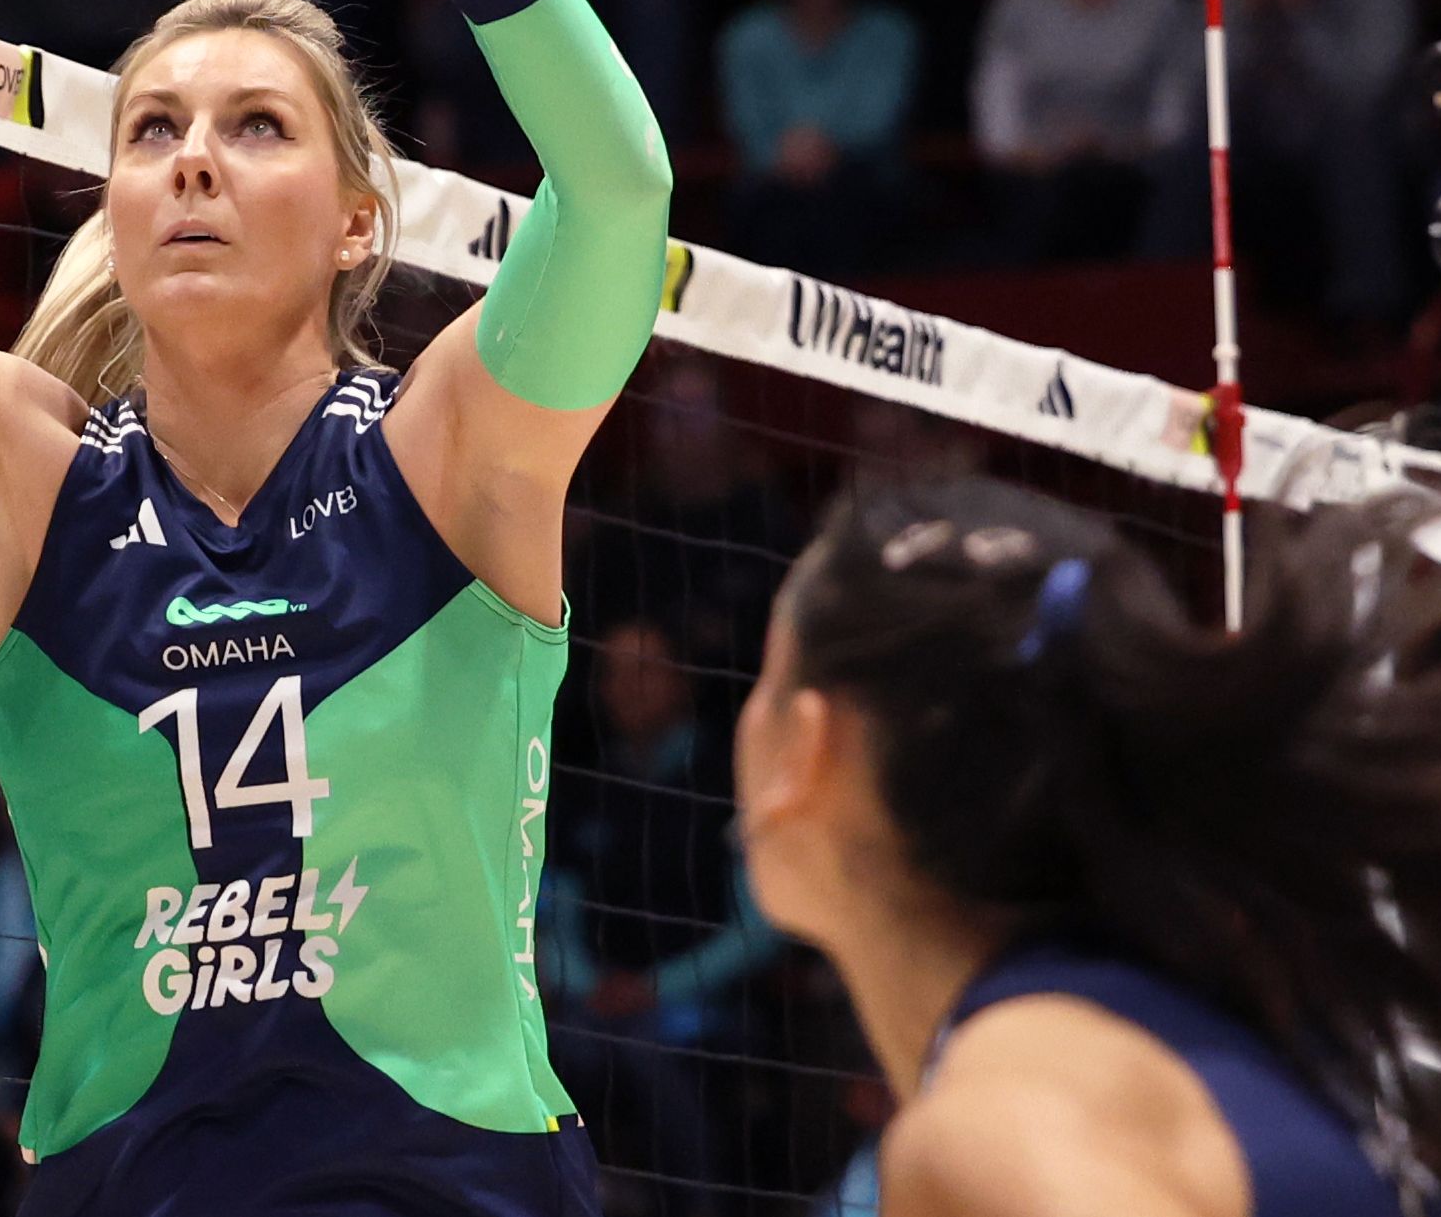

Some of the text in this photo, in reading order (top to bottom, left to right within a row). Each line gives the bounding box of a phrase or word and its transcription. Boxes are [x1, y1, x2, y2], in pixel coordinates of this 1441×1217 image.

[290, 485, 357, 539] LOVB
[162, 634, 295, 670] OMAHA
[138, 675, 330, 849] 14
[134, 868, 334, 949] REBEL
